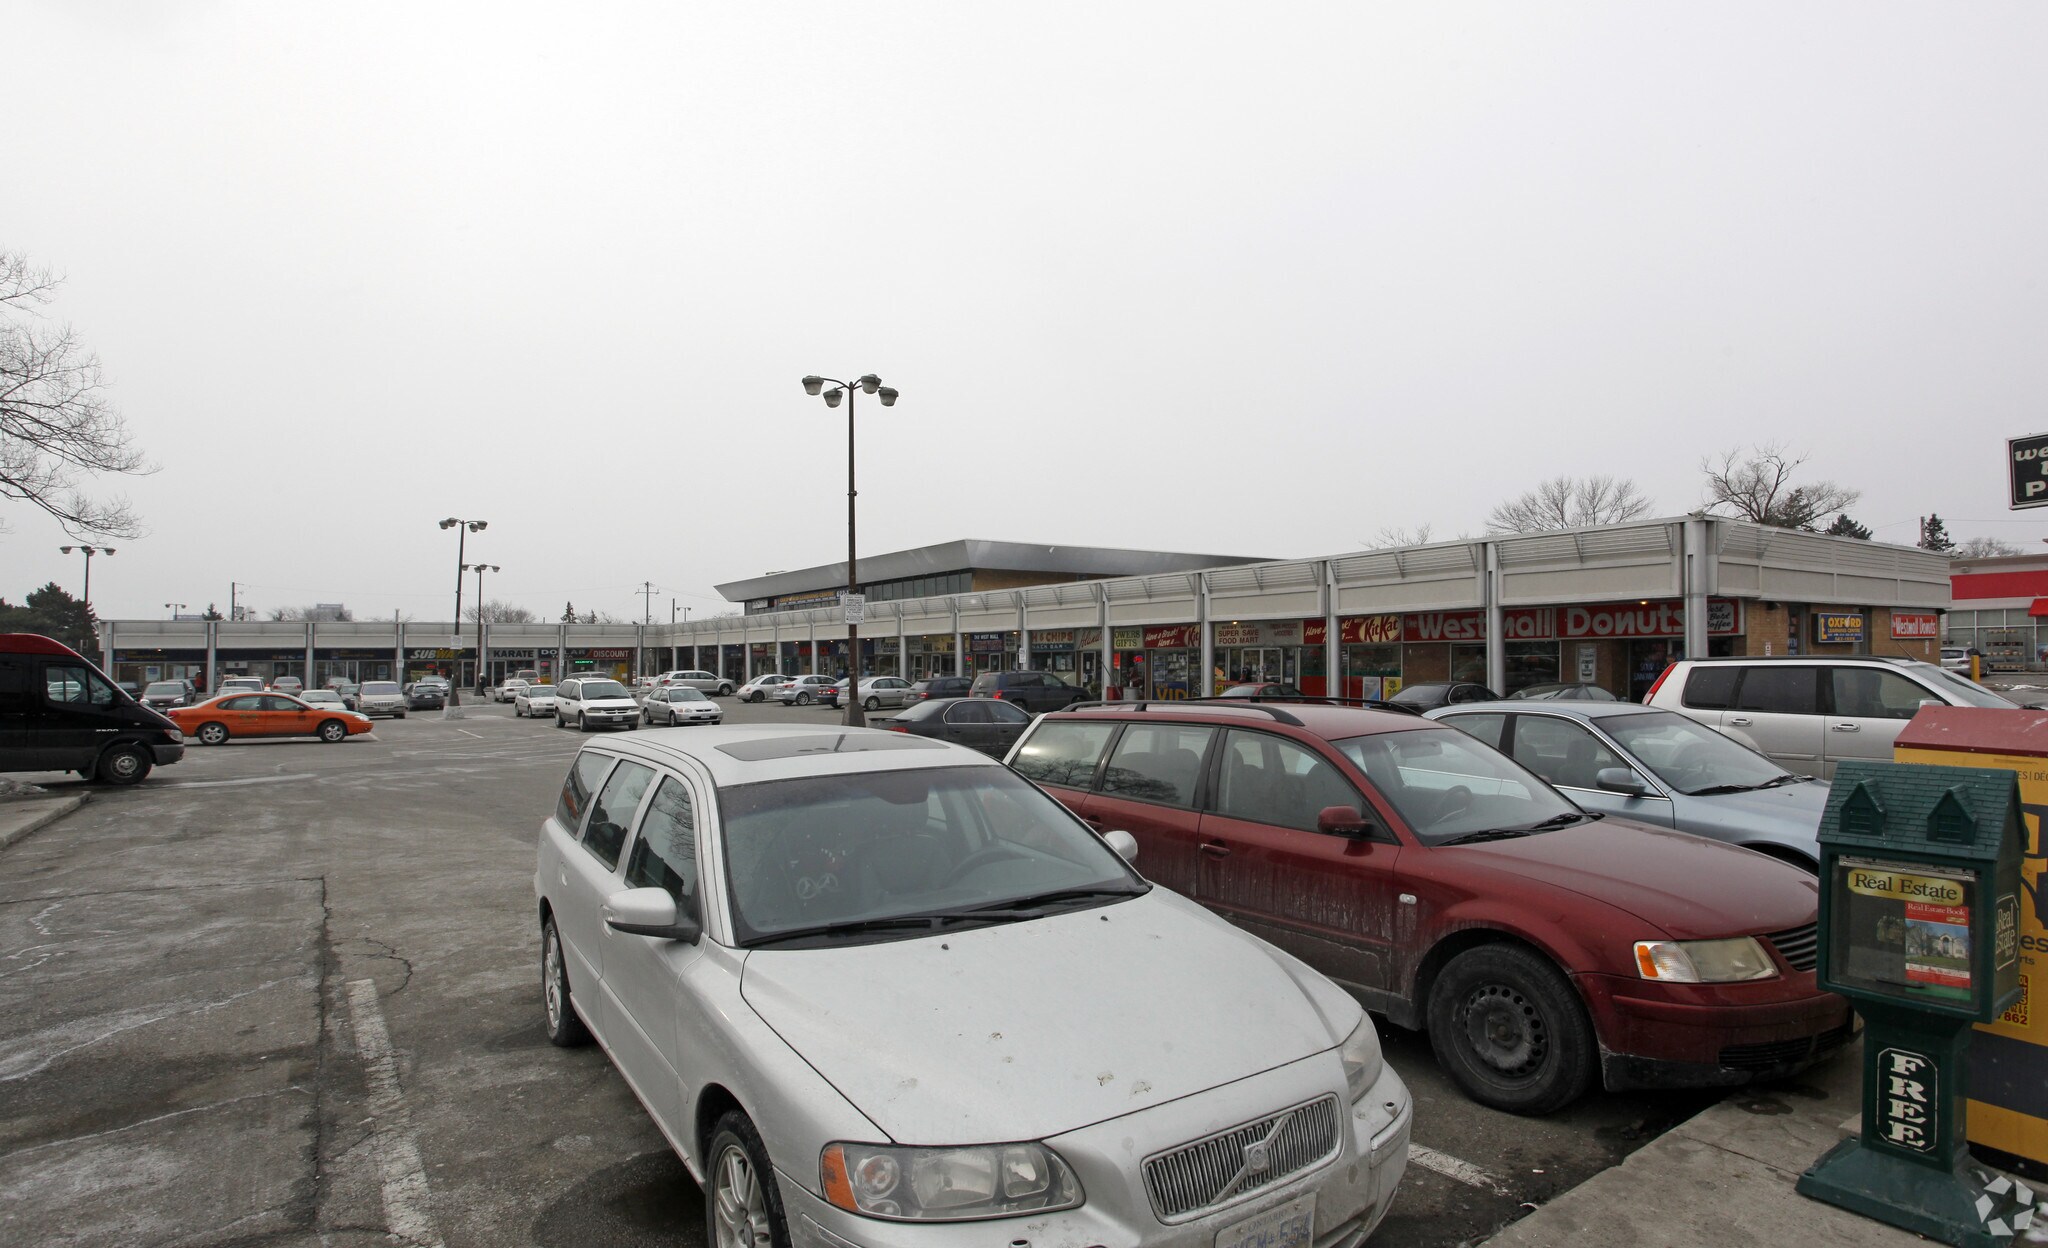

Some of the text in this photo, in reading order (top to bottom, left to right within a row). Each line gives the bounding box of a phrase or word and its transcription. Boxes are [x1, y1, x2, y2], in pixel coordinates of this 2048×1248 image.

[1828, 616, 1861, 627] OXFORD
[1895, 617, 1935, 634] Westmall Donuts
[1046, 632, 1073, 642] CHIPS
[1114, 630, 1140, 639] OWERS
[1145, 632, 1158, 641] Have
[1161, 627, 1180, 638] Break!
[1305, 627, 1321, 636] Have
[1116, 639, 1137, 647] GIFTS
[1157, 639, 1170, 647] Have
[410, 649, 465, 660] SUBWA
[494, 650, 534, 658] KARATE
[593, 650, 629, 658] DISCOUNT
[1854, 873, 1957, 900] Real Estate
[1908, 902, 1965, 916] Real Estate Book
[1997, 903, 2014, 932] Real
[1889, 1053, 1927, 1147] FREE
[1248, 1209, 1288, 1233] ONTARIO
